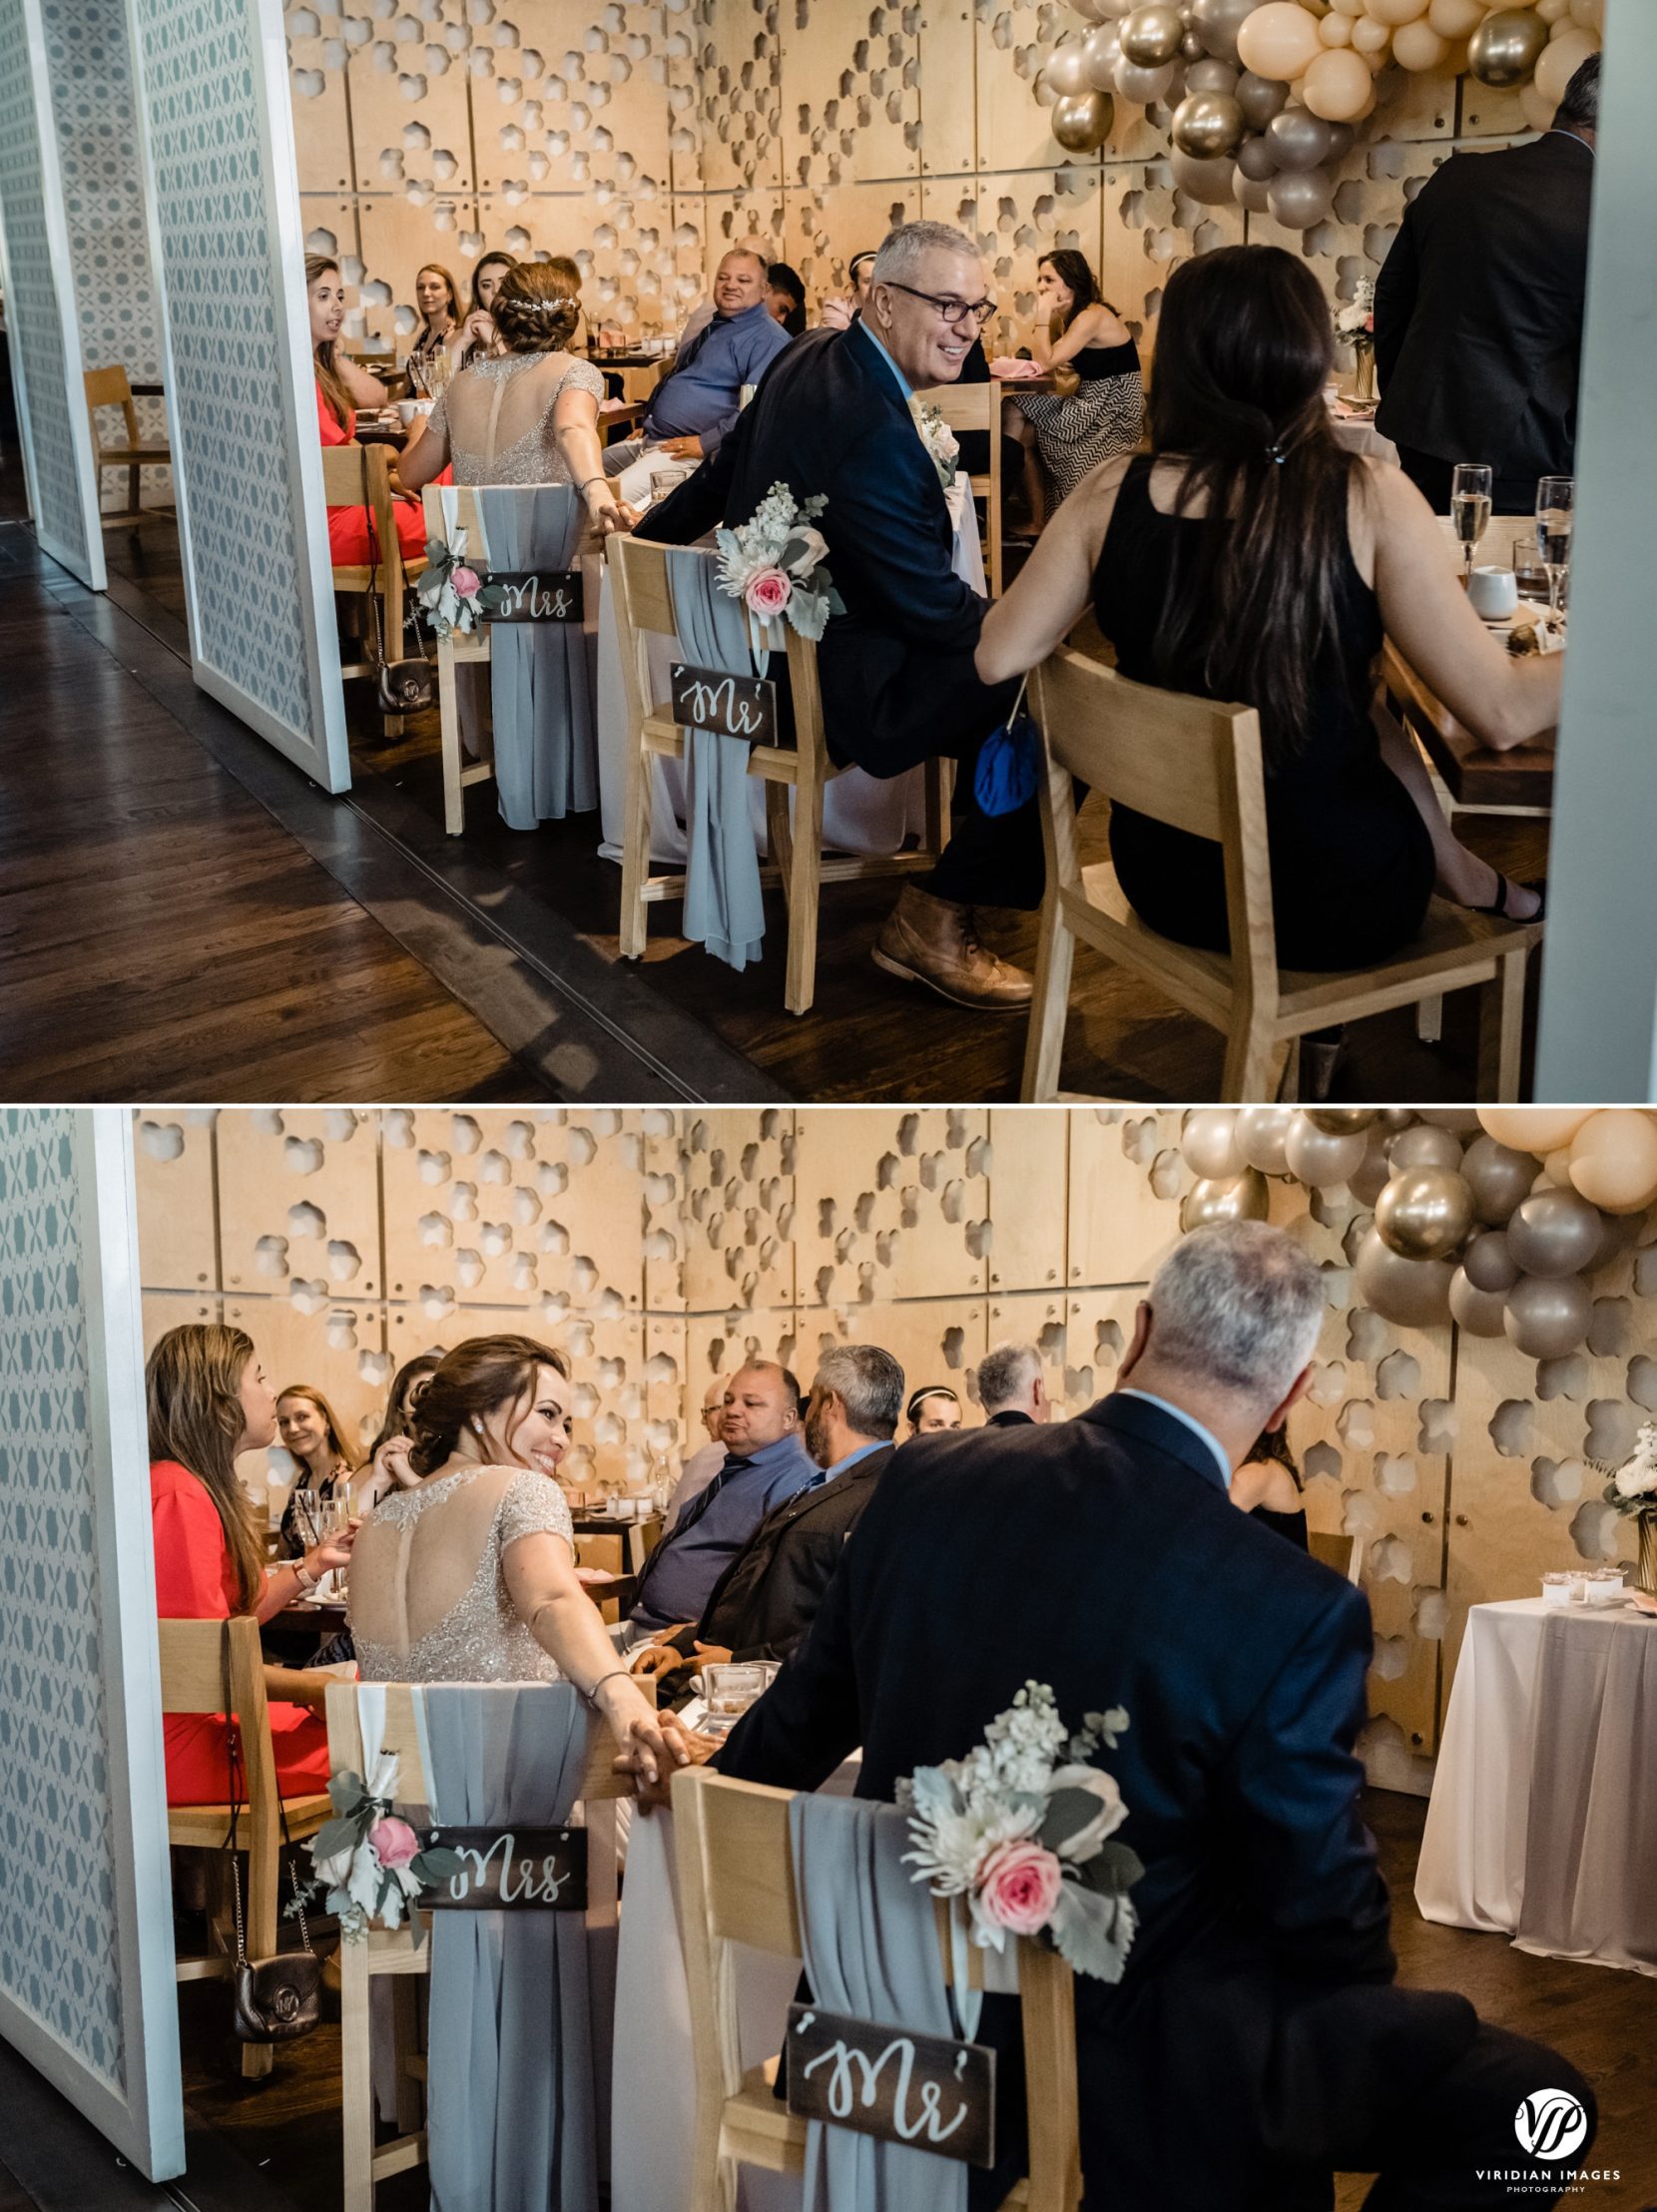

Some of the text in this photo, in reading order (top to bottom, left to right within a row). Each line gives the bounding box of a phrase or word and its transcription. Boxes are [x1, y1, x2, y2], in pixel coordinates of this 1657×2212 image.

[500, 576, 574, 618] Mrs
[680, 678, 763, 735] Mr
[449, 1833, 571, 1903] Mrs
[804, 2037, 968, 2143] Mr
